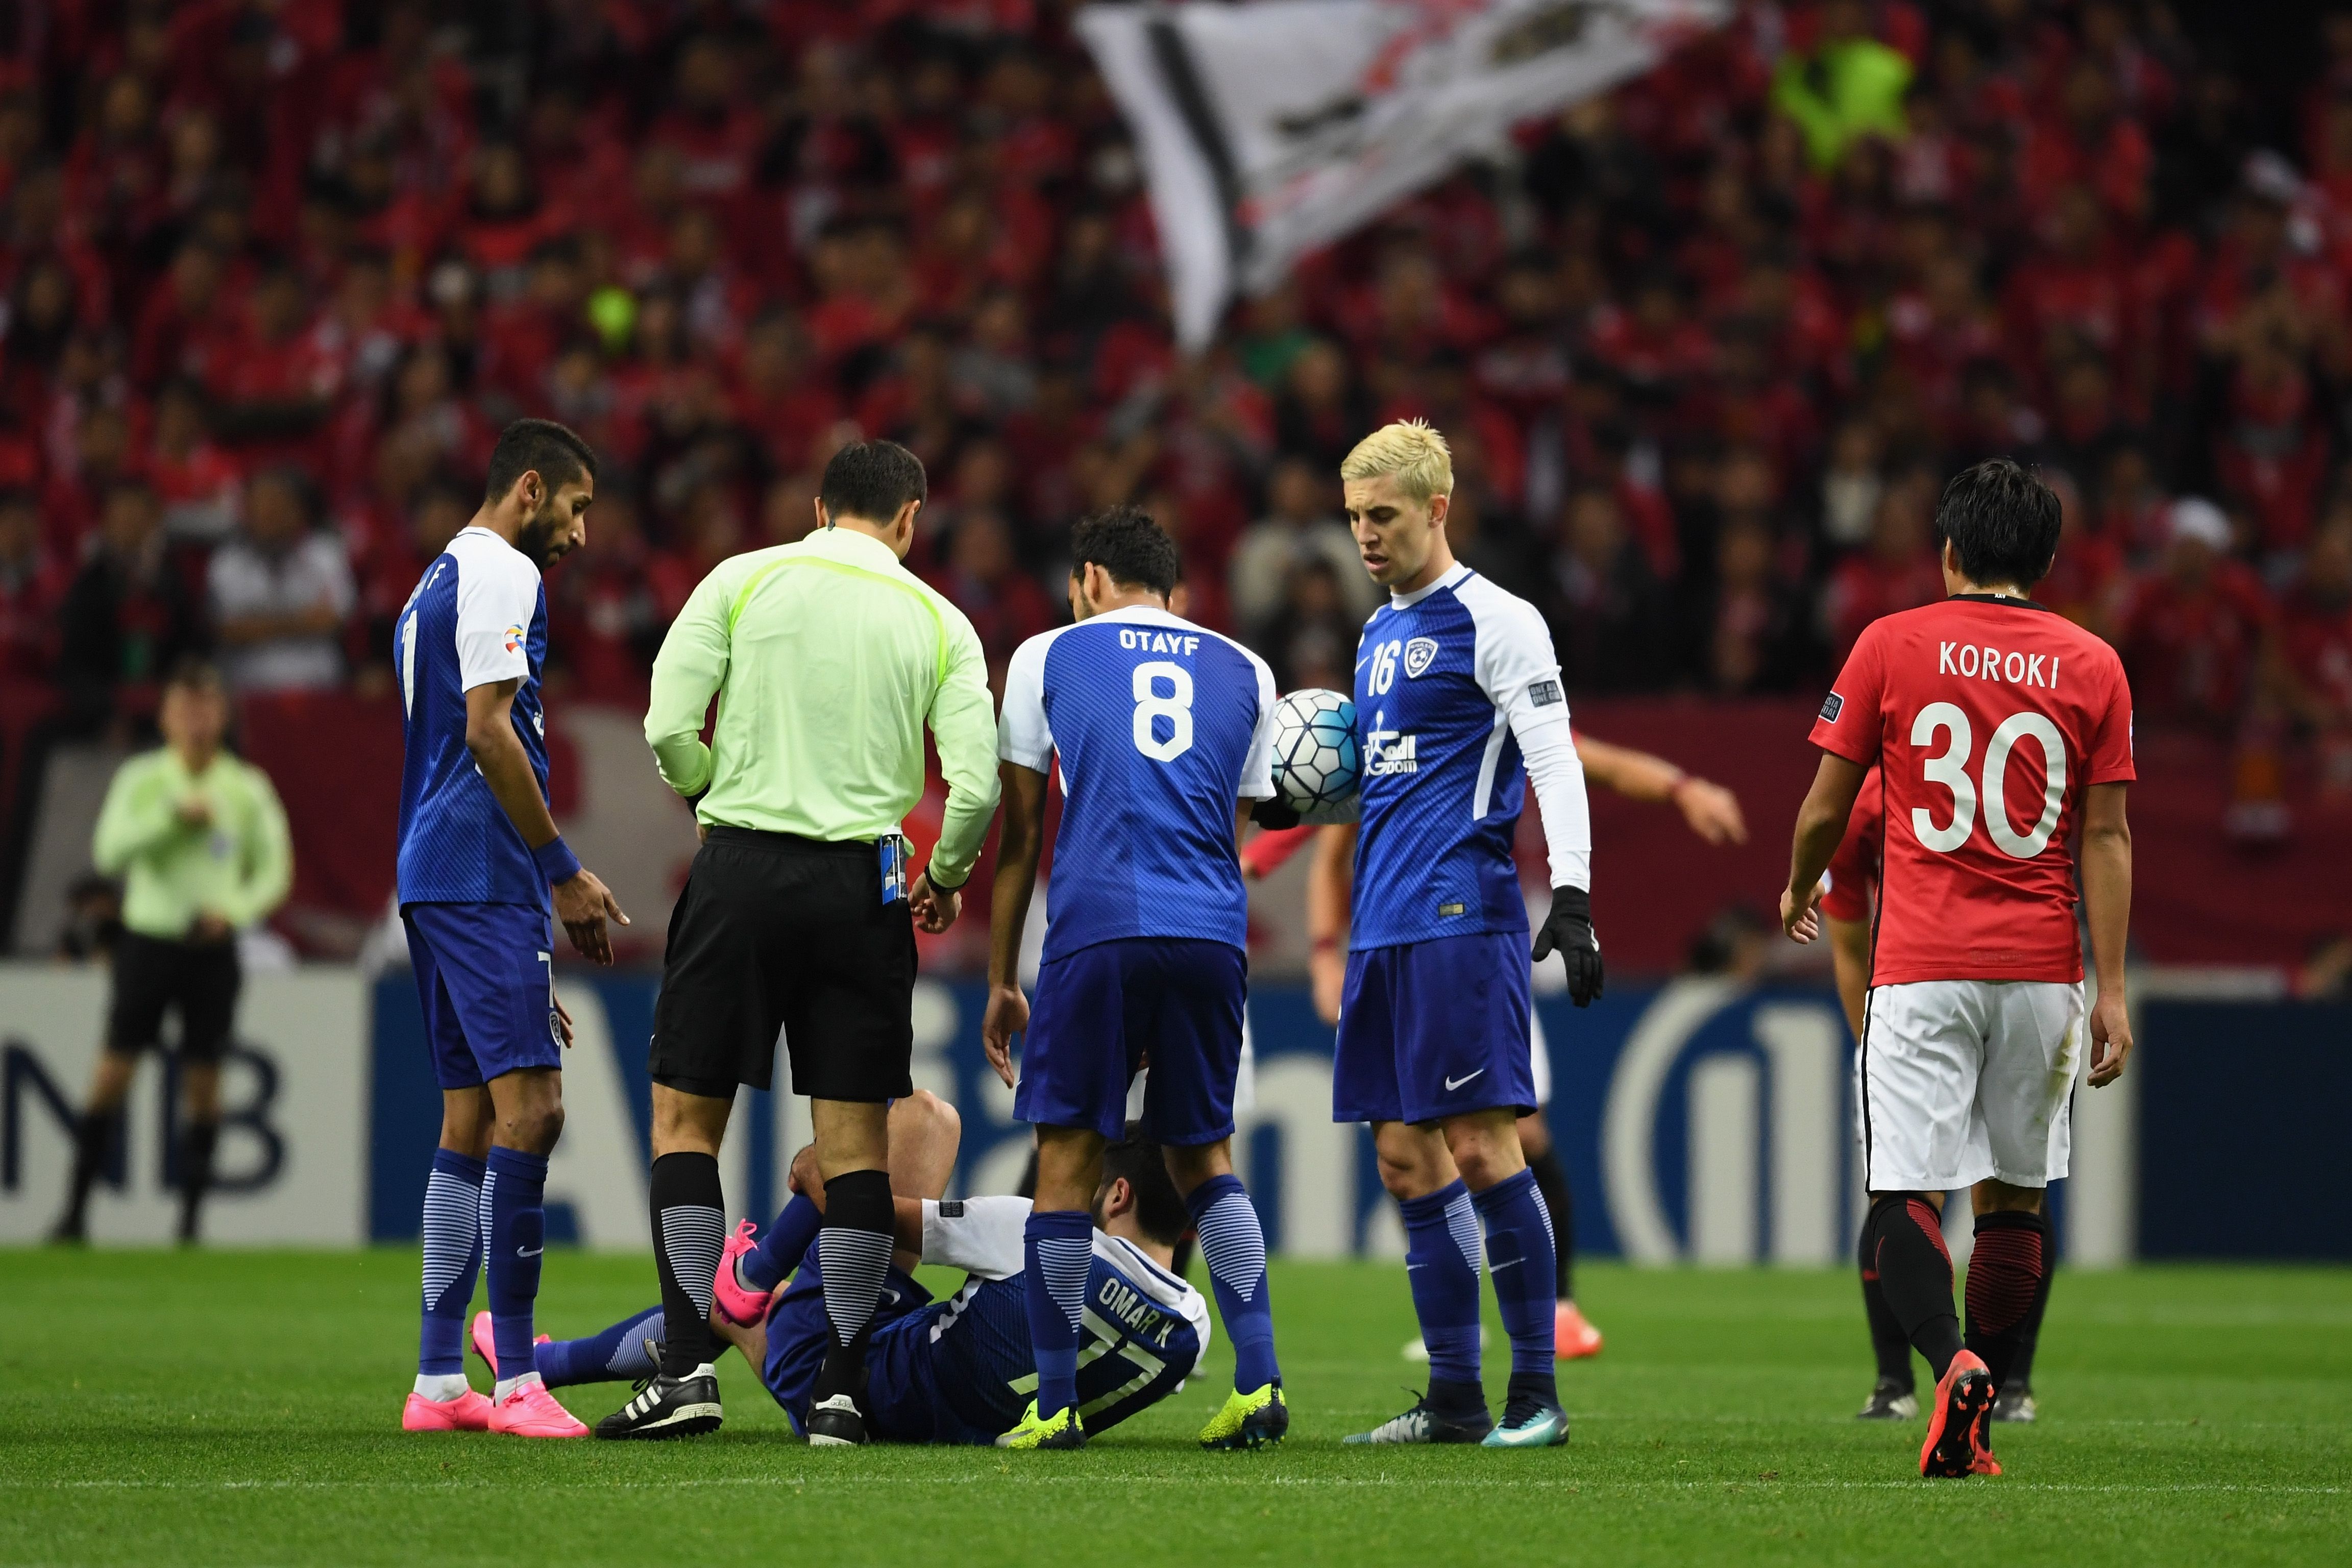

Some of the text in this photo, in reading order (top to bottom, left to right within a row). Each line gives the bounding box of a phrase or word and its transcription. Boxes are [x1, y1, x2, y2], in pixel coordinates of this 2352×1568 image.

[1119, 629, 1199, 656] OTAYF
[1368, 640, 1401, 697] 16
[1940, 641, 2059, 689] KOROKI
[1132, 662, 1193, 763] 8
[1820, 704, 1836, 718] OAL
[1825, 697, 1839, 709] SIA
[1910, 701, 2067, 859] 30
[537, 951, 554, 1009] 7
[1099, 1278, 1174, 1349] OMAR K
